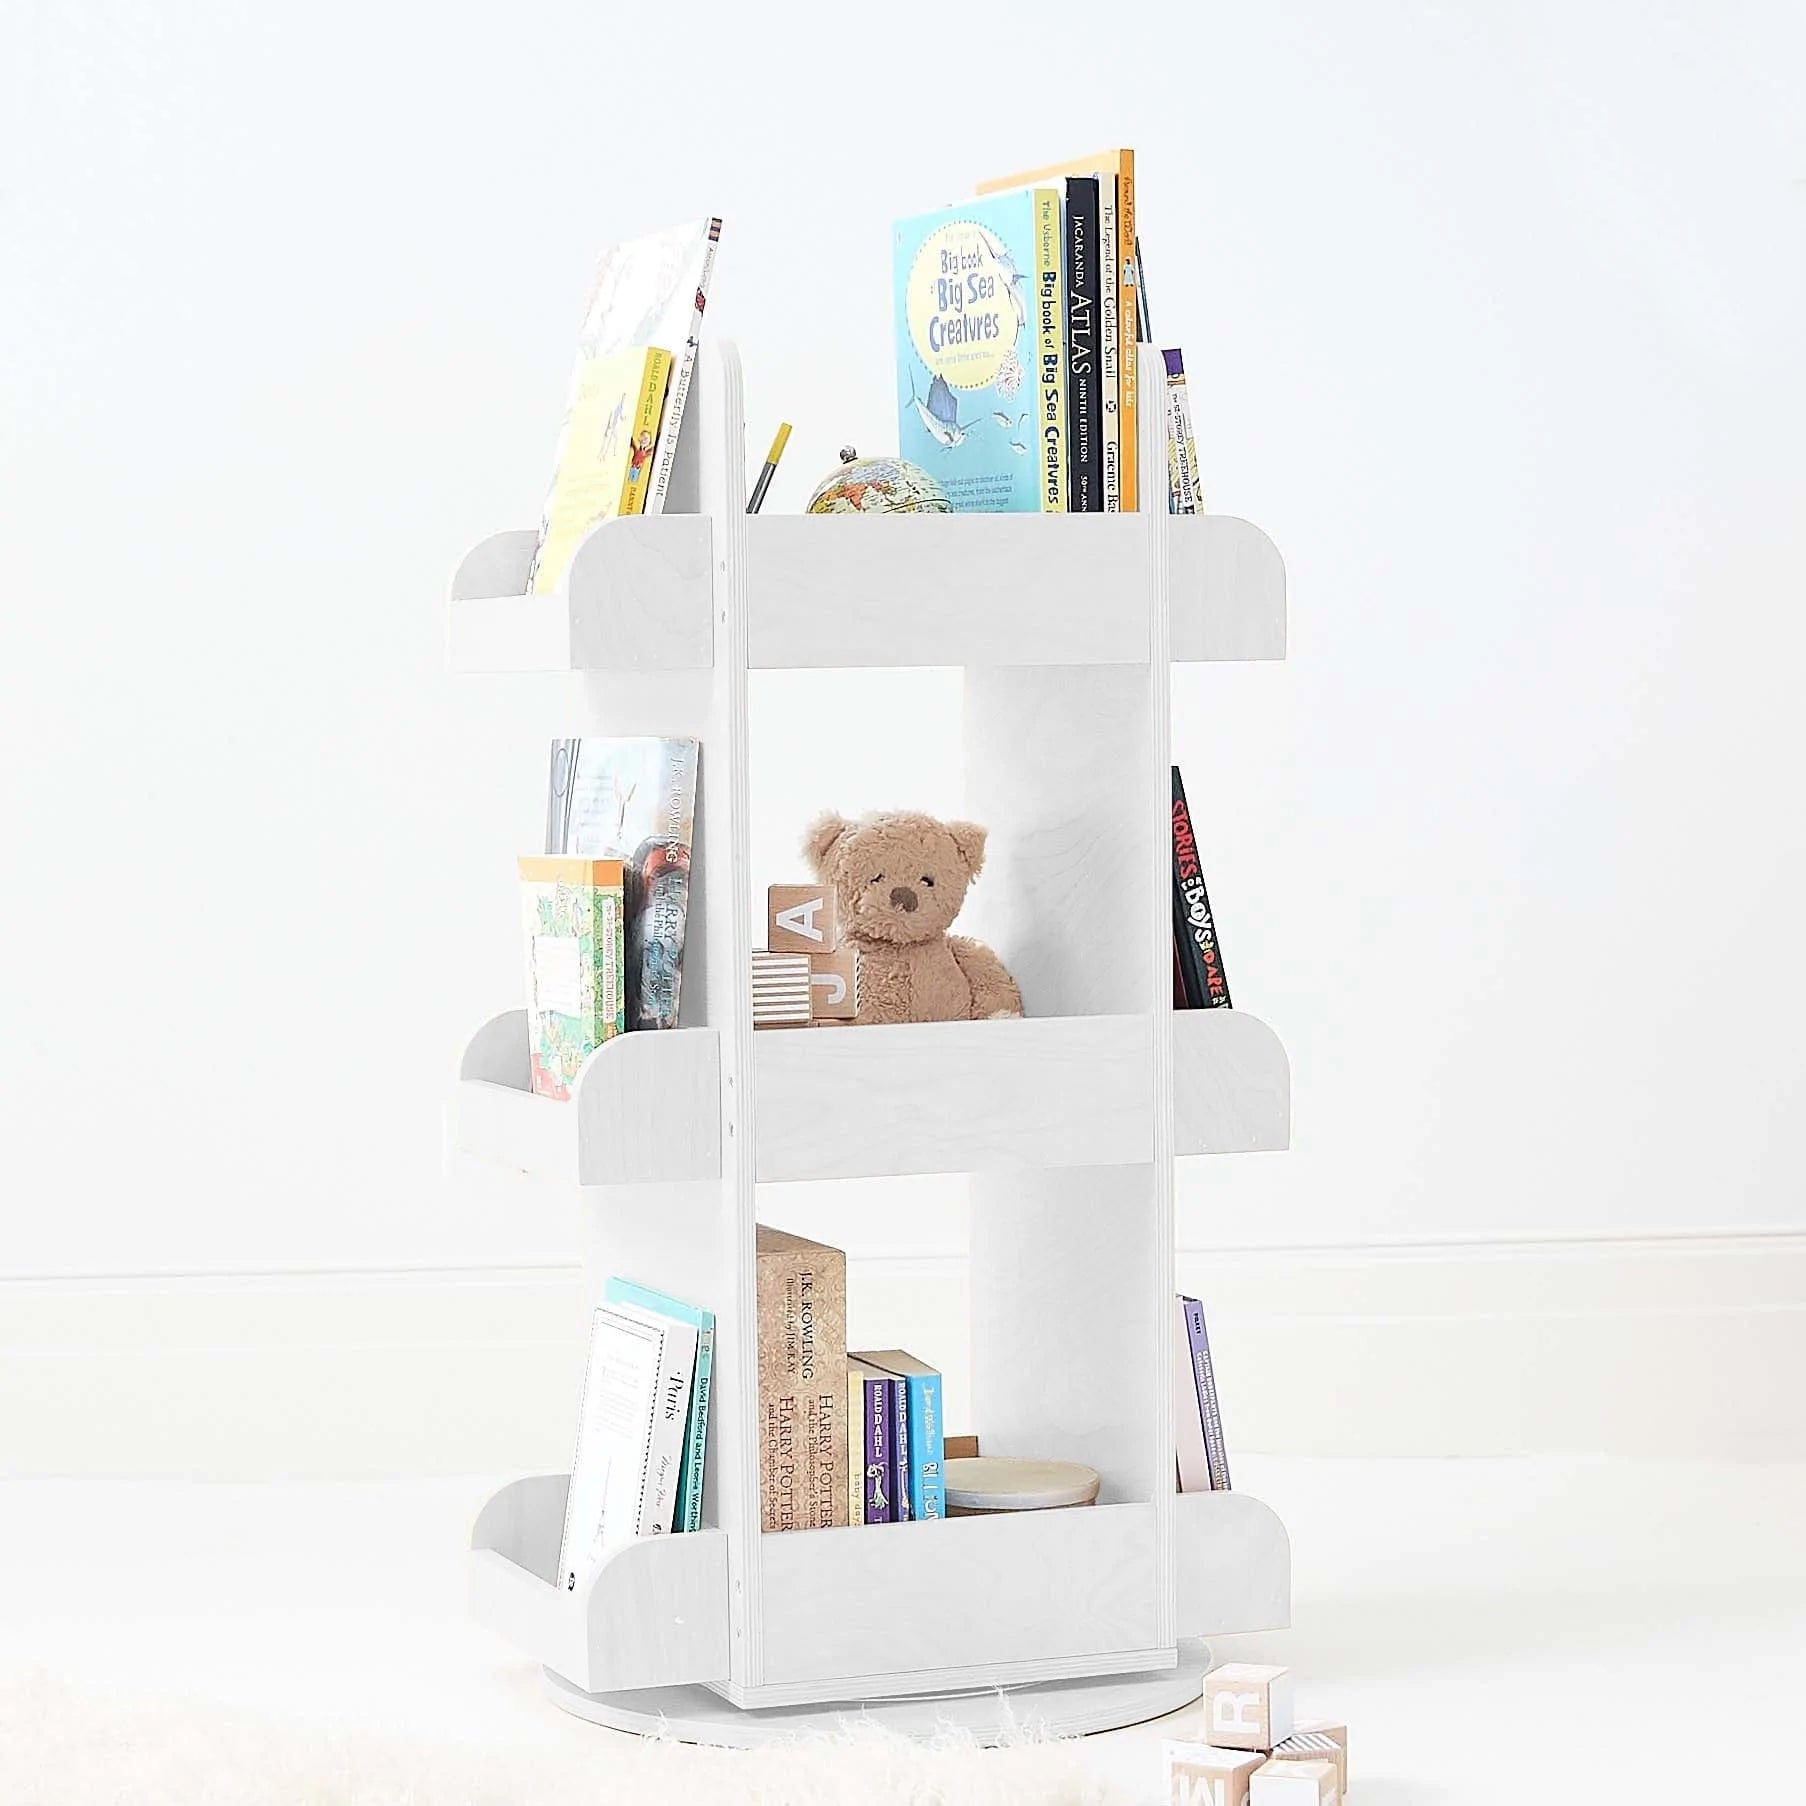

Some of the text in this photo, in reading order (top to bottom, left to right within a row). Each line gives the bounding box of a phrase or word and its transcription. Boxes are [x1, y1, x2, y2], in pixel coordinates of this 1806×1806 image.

[1104, 205, 1112, 224] The
[940, 243, 984, 275] Big book
[1102, 227, 1114, 261] Legend
[937, 277, 963, 313] Big
[967, 273, 995, 304] Sea
[1105, 275, 1115, 295] the
[929, 313, 1000, 353] Creatures
[1070, 215, 1093, 463] JACARANDA ATLAS NINTH EDITION
[1104, 297, 1117, 342] Golden
[1041, 201, 1060, 504] The Usborne Big book of Big Sea Creatures
[1104, 346, 1117, 378] Snail
[643, 352, 662, 426] ROALD DAHL
[669, 367, 690, 427] Butterfly
[656, 451, 674, 497] Patient
[1106, 441, 1118, 495] Graeme
[1178, 447, 1193, 503] TREEHOUSE
[665, 787, 681, 863] ROWLING
[1172, 799, 1199, 879] STORIES
[1181, 876, 1203, 890] FOR
[664, 877, 683, 943] HARRY
[776, 898, 824, 943] A
[811, 973, 847, 1005] J
[1203, 949, 1224, 997] DARE
[786, 1333, 796, 1350] JIM
[799, 1272, 814, 1379] J.K. ROWLING
[787, 1353, 796, 1374] KAY
[665, 1376, 685, 1420] Paris
[699, 1378, 709, 1403] David
[696, 1405, 706, 1440] Bedford
[873, 1384, 883, 1458] ROALD DAHL
[899, 1380, 908, 1456] ROALD DAHL
[694, 1442, 703, 1460] and
[768, 1403, 778, 1529] and the Chamber of Secrets
[780, 1396, 794, 1532] HARRY POTTER
[807, 1399, 818, 1528] and the Philosopher's Stone
[819, 1395, 834, 1528] HARRY POTTER
[851, 1472, 861, 1498] baby
[1213, 1691, 1261, 1734] R
